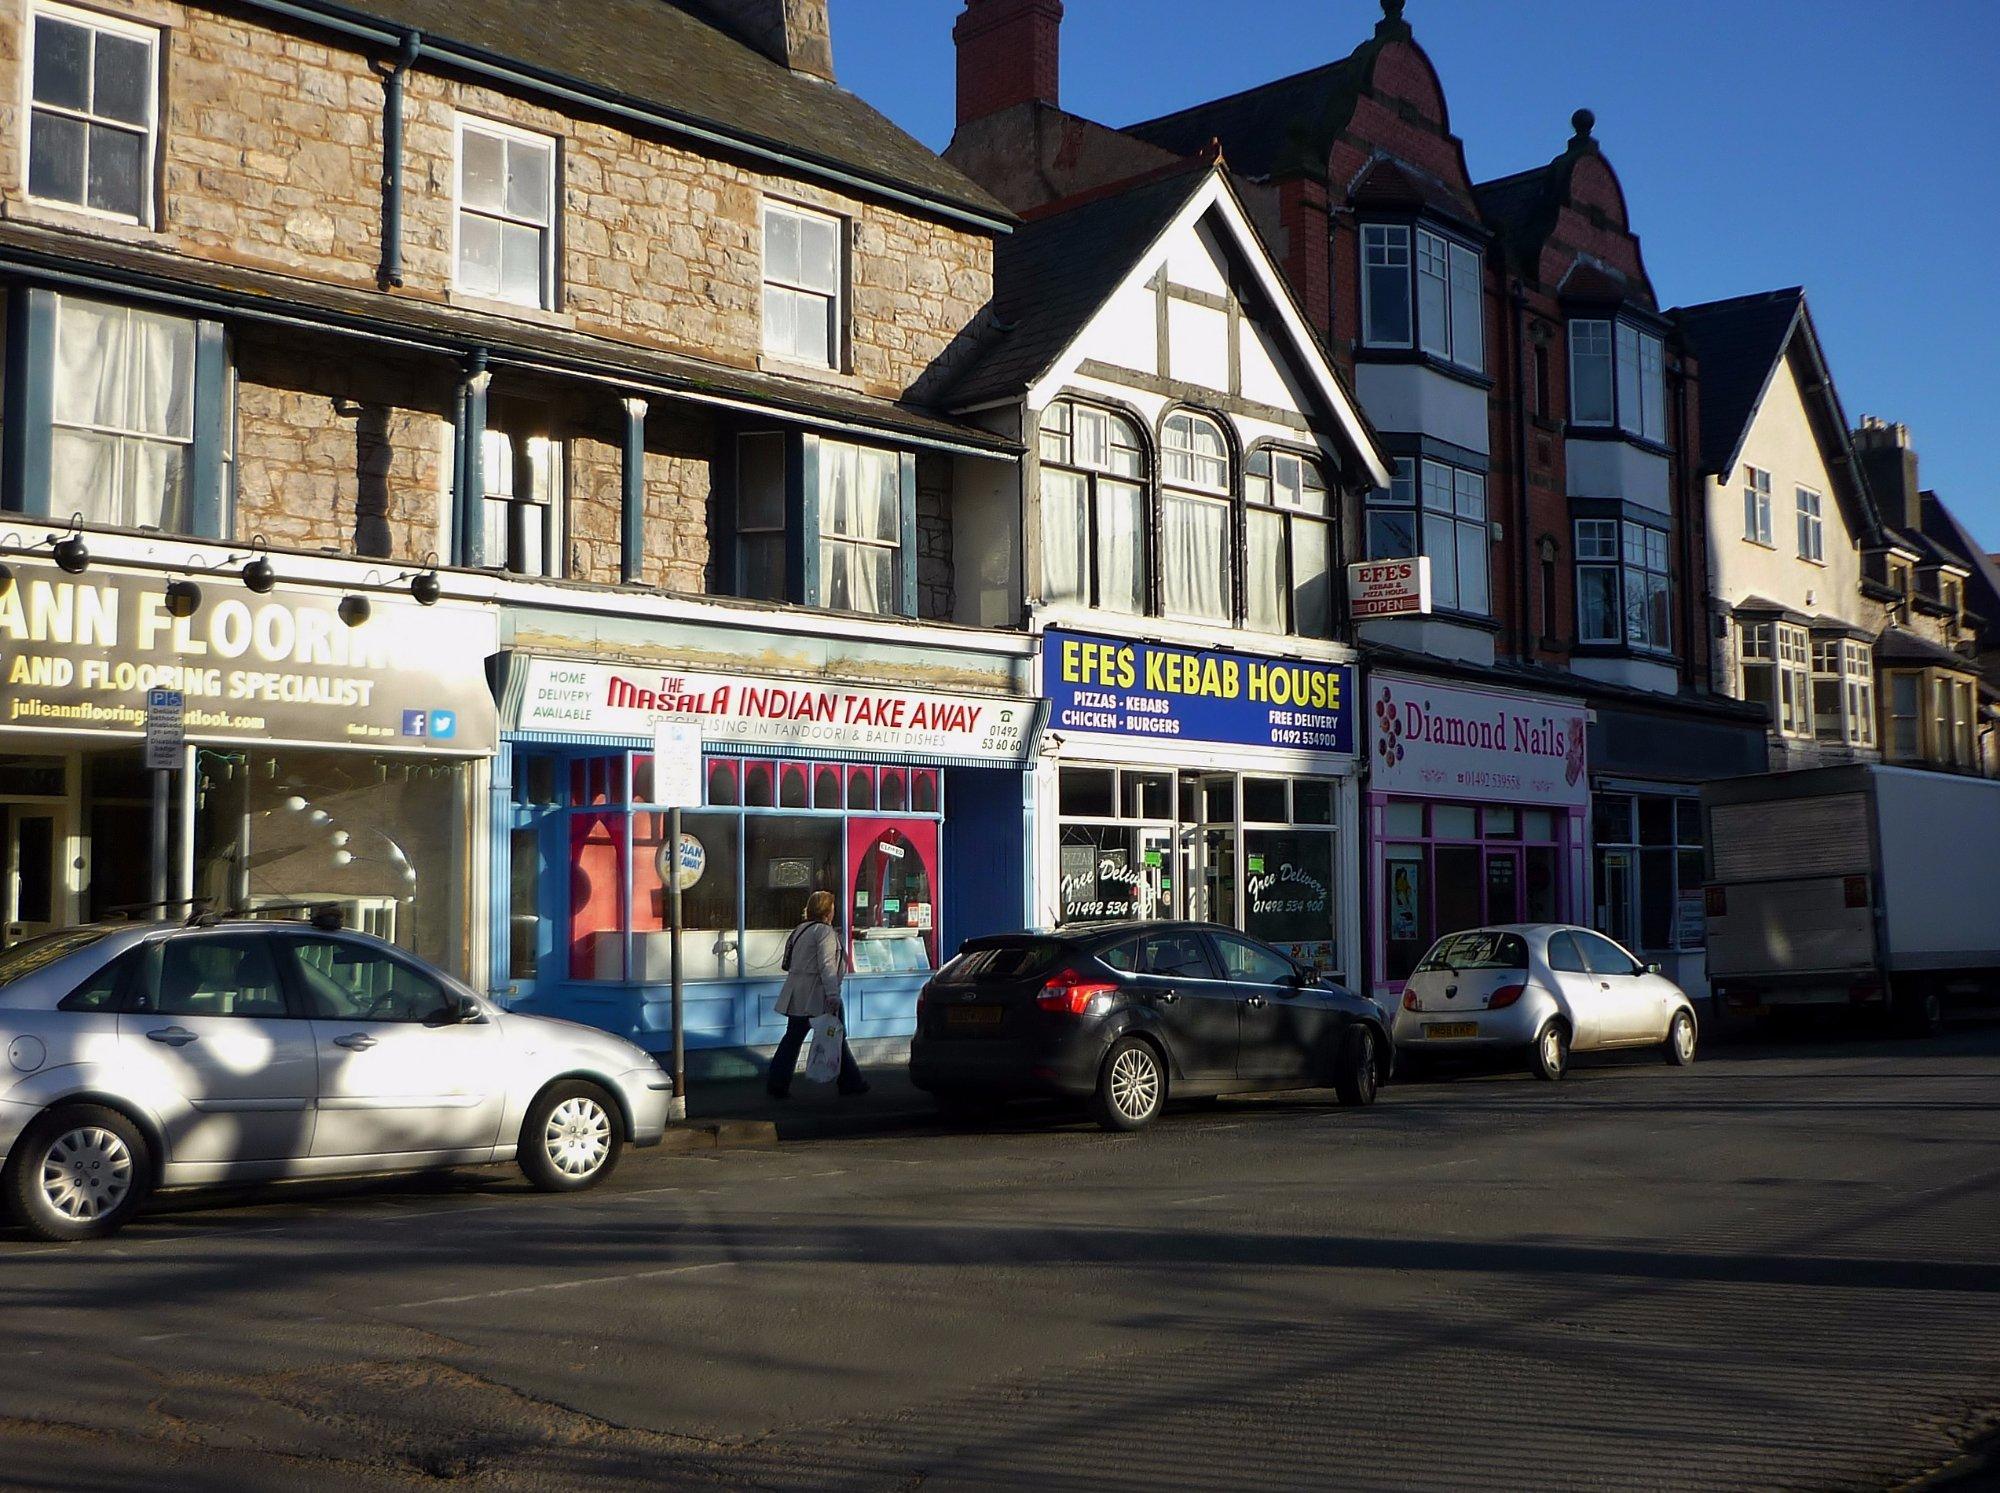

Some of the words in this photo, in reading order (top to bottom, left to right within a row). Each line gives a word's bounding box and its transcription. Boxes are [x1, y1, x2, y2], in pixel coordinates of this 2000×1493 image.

[1363, 590, 1383, 598] PIZZA
[1385, 588, 1409, 596] HOUSE
[1367, 600, 1404, 613] OPEN
[9, 654, 74, 687] AND
[81, 659, 222, 697] FLOORING
[228, 670, 374, 707] SPECIALIST
[549, 671, 587, 685] HOME
[1062, 640, 1136, 689] EFES
[1145, 650, 1240, 699] KEBAB
[1248, 662, 1341, 710] HOUSE
[660, 676, 686, 694] THE
[154, 692, 164, 705] P
[538, 687, 593, 702] DELIVERY
[1073, 690, 1117, 709] PIZZAS
[1126, 696, 1170, 715] KEBABS
[532, 706, 592, 721] AVAILABLE
[738, 686, 839, 723] INDIAN
[843, 695, 907, 728] TAKE
[908, 702, 983, 733] AWAY
[1061, 709, 1117, 728] CHICKEN
[1126, 715, 1180, 734] BURGERS
[1269, 710, 1293, 726] FREE
[1294, 712, 1339, 730] DELIVERY
[1405, 699, 1507, 752] Diamond
[1513, 716, 1565, 758] Nails
[754, 723, 768, 735] IN
[774, 723, 846, 742] TANDOORI
[852, 732, 861, 741] &
[866, 732, 900, 744] BALTI
[904, 734, 946, 747] DISHES
[989, 725, 1019, 738] 01492
[1271, 728, 1301, 744] 01492
[1302, 731, 1336, 747] 534900
[981, 738, 996, 750] 53
[996, 739, 1009, 751] 60
[1010, 740, 1023, 751] 60
[1465, 772, 1490, 788] 01492
[1060, 870, 1095, 902] Free
[1248, 873, 1277, 901] Free
[1280, 862, 1328, 899] Delivery
[1066, 901, 1103, 917] 01492
[1105, 901, 1129, 915] 534
[1253, 900, 1285, 913] 01492
[1285, 900, 1304, 912] 534
[1306, 900, 1325, 912] 900
